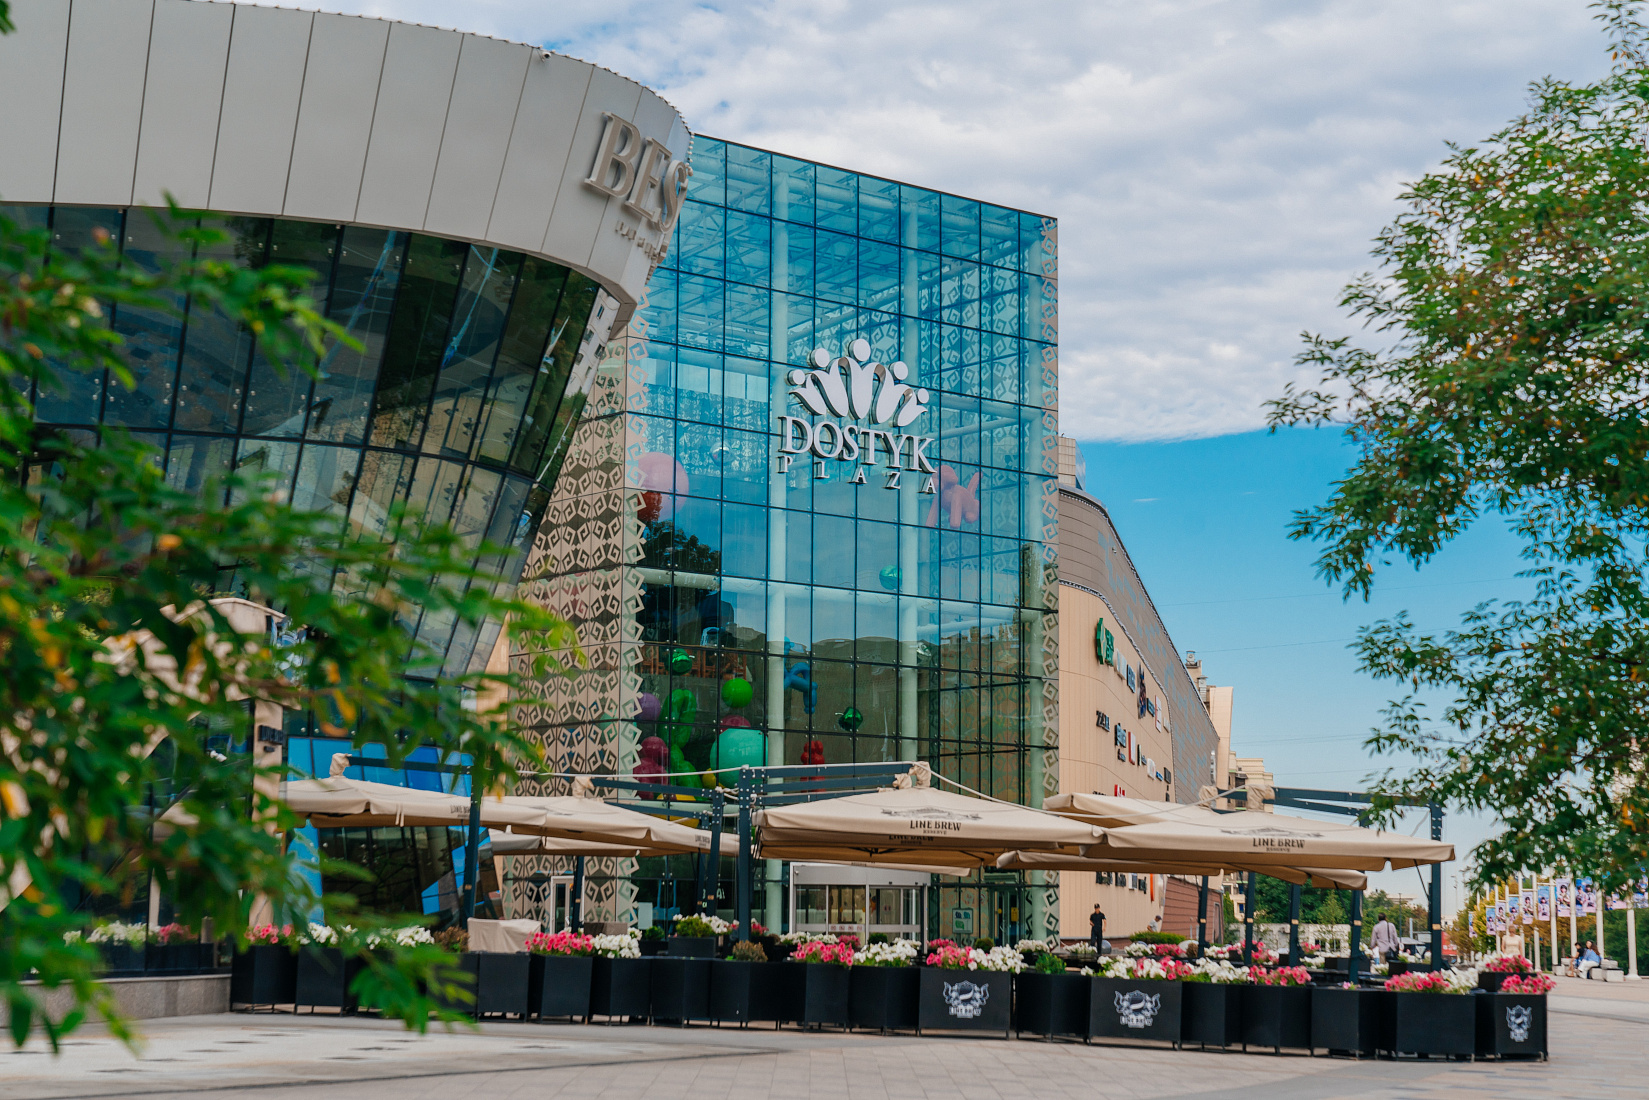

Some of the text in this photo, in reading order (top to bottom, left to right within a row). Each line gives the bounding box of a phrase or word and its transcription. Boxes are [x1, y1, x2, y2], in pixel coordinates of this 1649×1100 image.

[778, 415, 937, 474] DOSTYK
[777, 455, 937, 495] PLAZA
[910, 820, 961, 831] LINE BREW
[1253, 838, 1305, 849] LINE BREW
